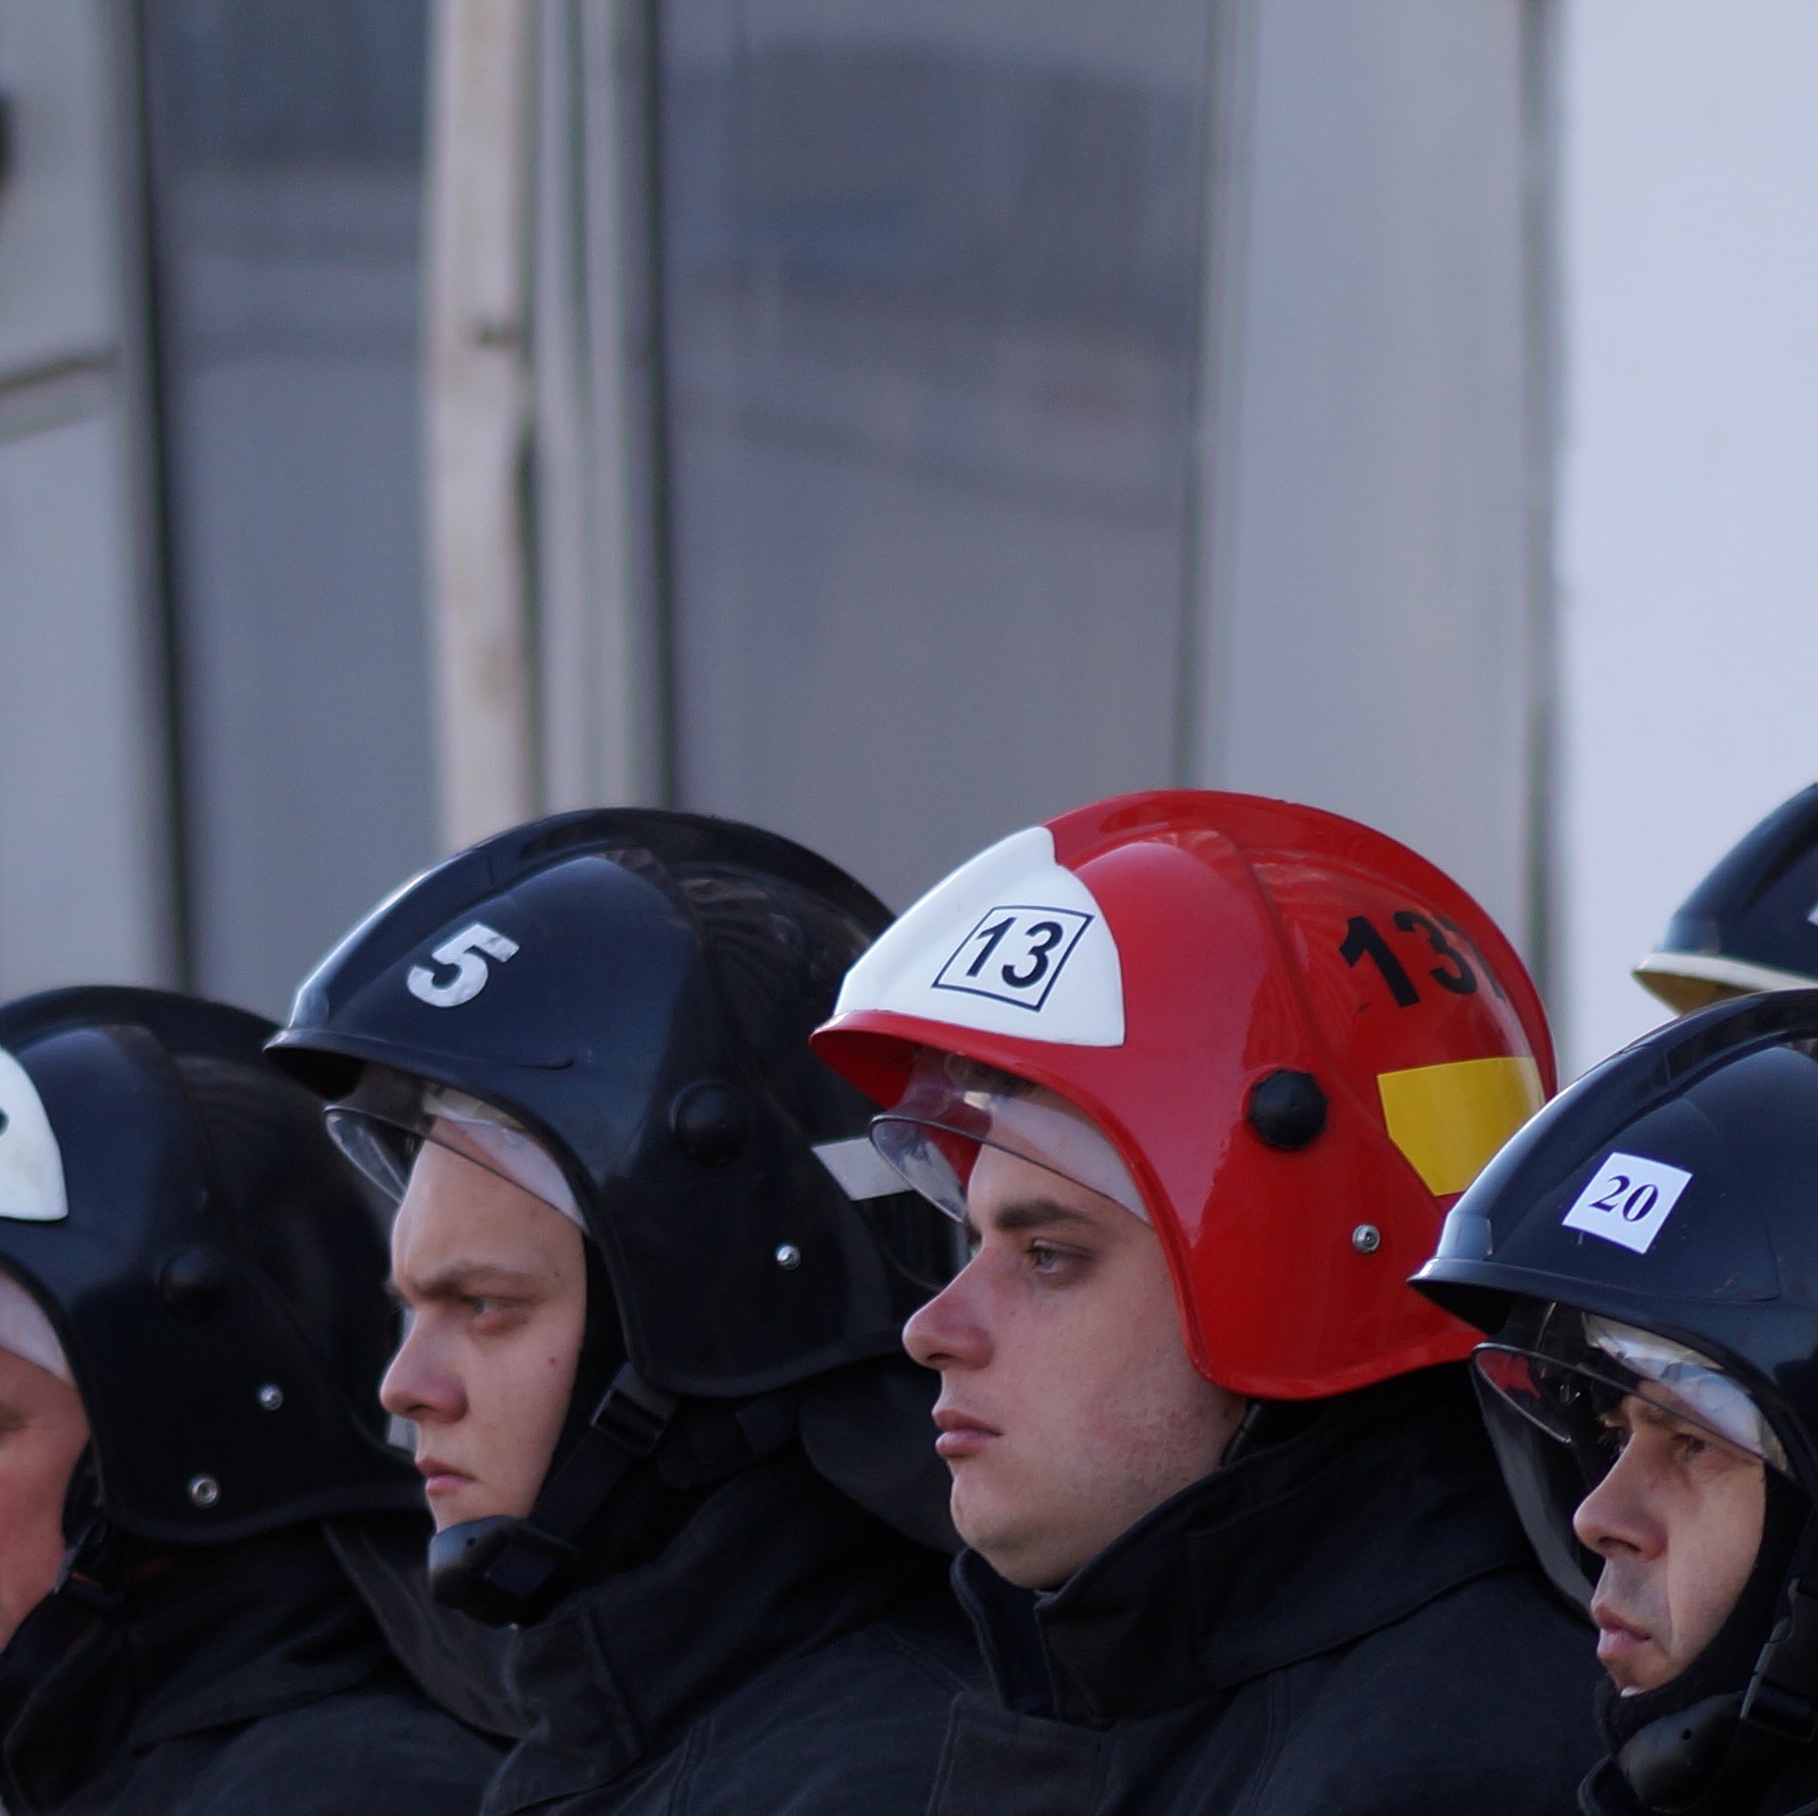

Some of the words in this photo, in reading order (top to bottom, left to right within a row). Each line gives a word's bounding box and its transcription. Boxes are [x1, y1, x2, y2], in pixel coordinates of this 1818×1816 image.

[407, 923, 520, 1008] 5
[965, 916, 1063, 988] 13
[1587, 1175, 1658, 1222] 20
